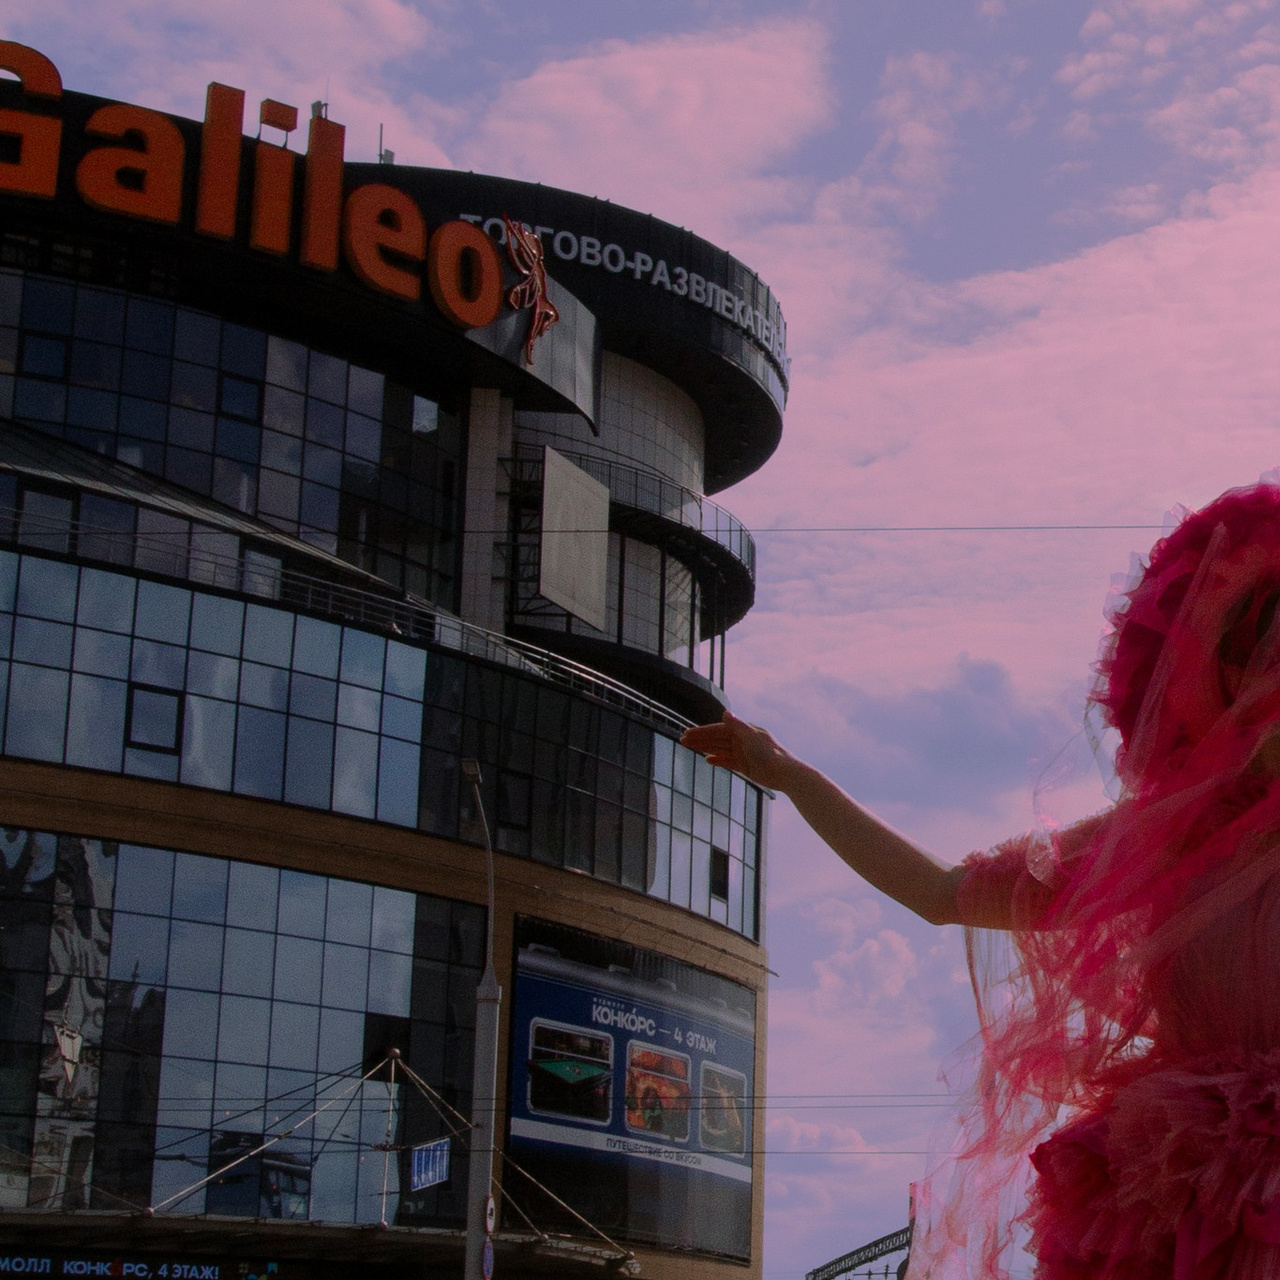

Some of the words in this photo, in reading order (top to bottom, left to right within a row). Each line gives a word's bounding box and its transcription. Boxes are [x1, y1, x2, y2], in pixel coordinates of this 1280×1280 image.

[674, 1027, 683, 1044] 4
[686, 1031, 717, 1055] ЭТАЖ
[157, 1264, 169, 1278] 4
[171, 1264, 220, 1280] ЭТАЖ!
